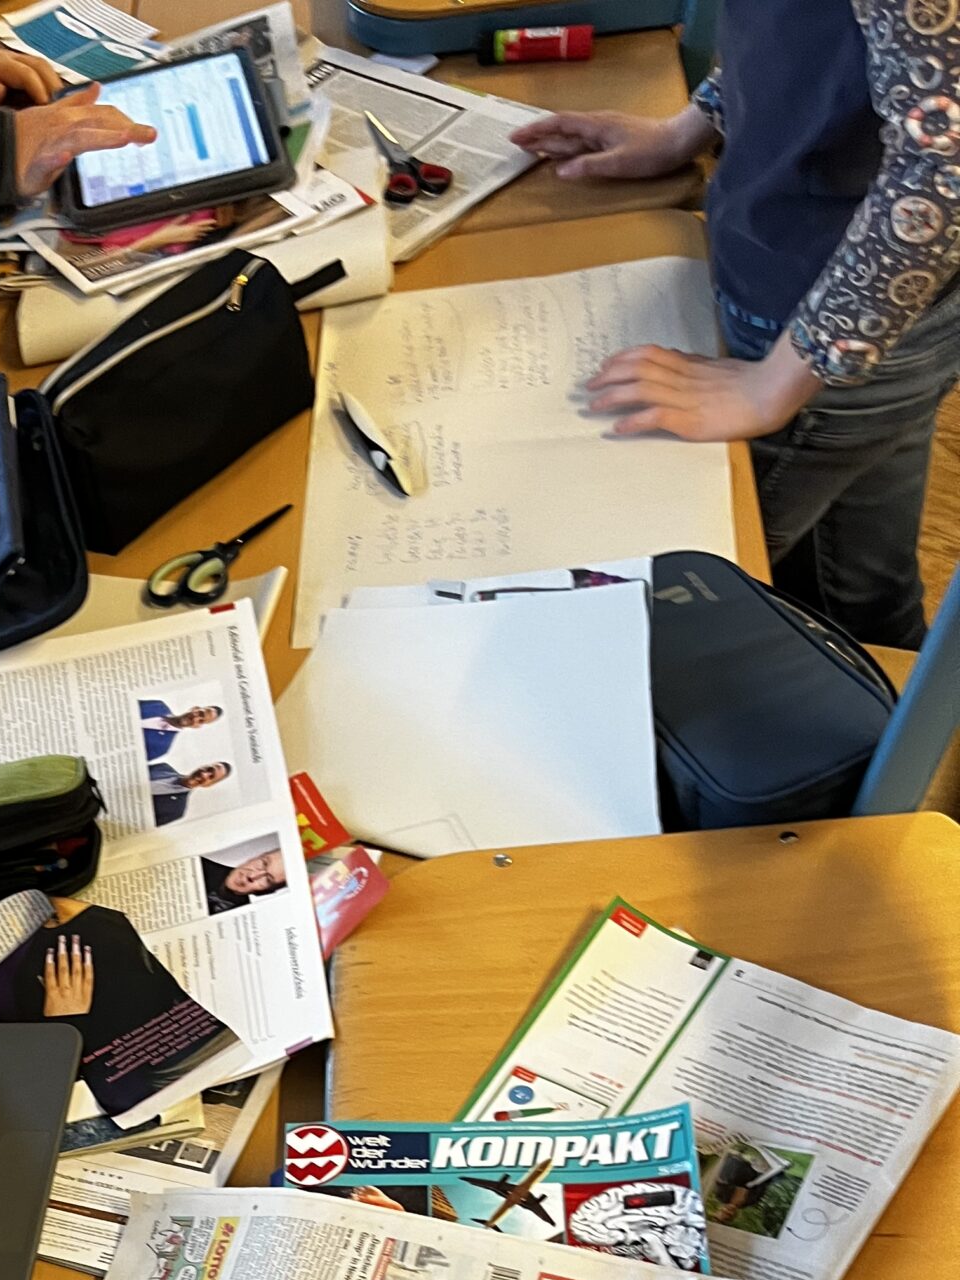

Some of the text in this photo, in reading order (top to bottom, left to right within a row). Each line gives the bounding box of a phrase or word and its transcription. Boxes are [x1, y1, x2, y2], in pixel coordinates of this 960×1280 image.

[347, 1134, 390, 1146] welt
[434, 1122, 679, 1167] KOMPAKT
[352, 1147, 385, 1158] der
[349, 1156, 429, 1169] wunder
[207, 1239, 229, 1279] LOTTO
[345, 1265, 357, 1280] New
